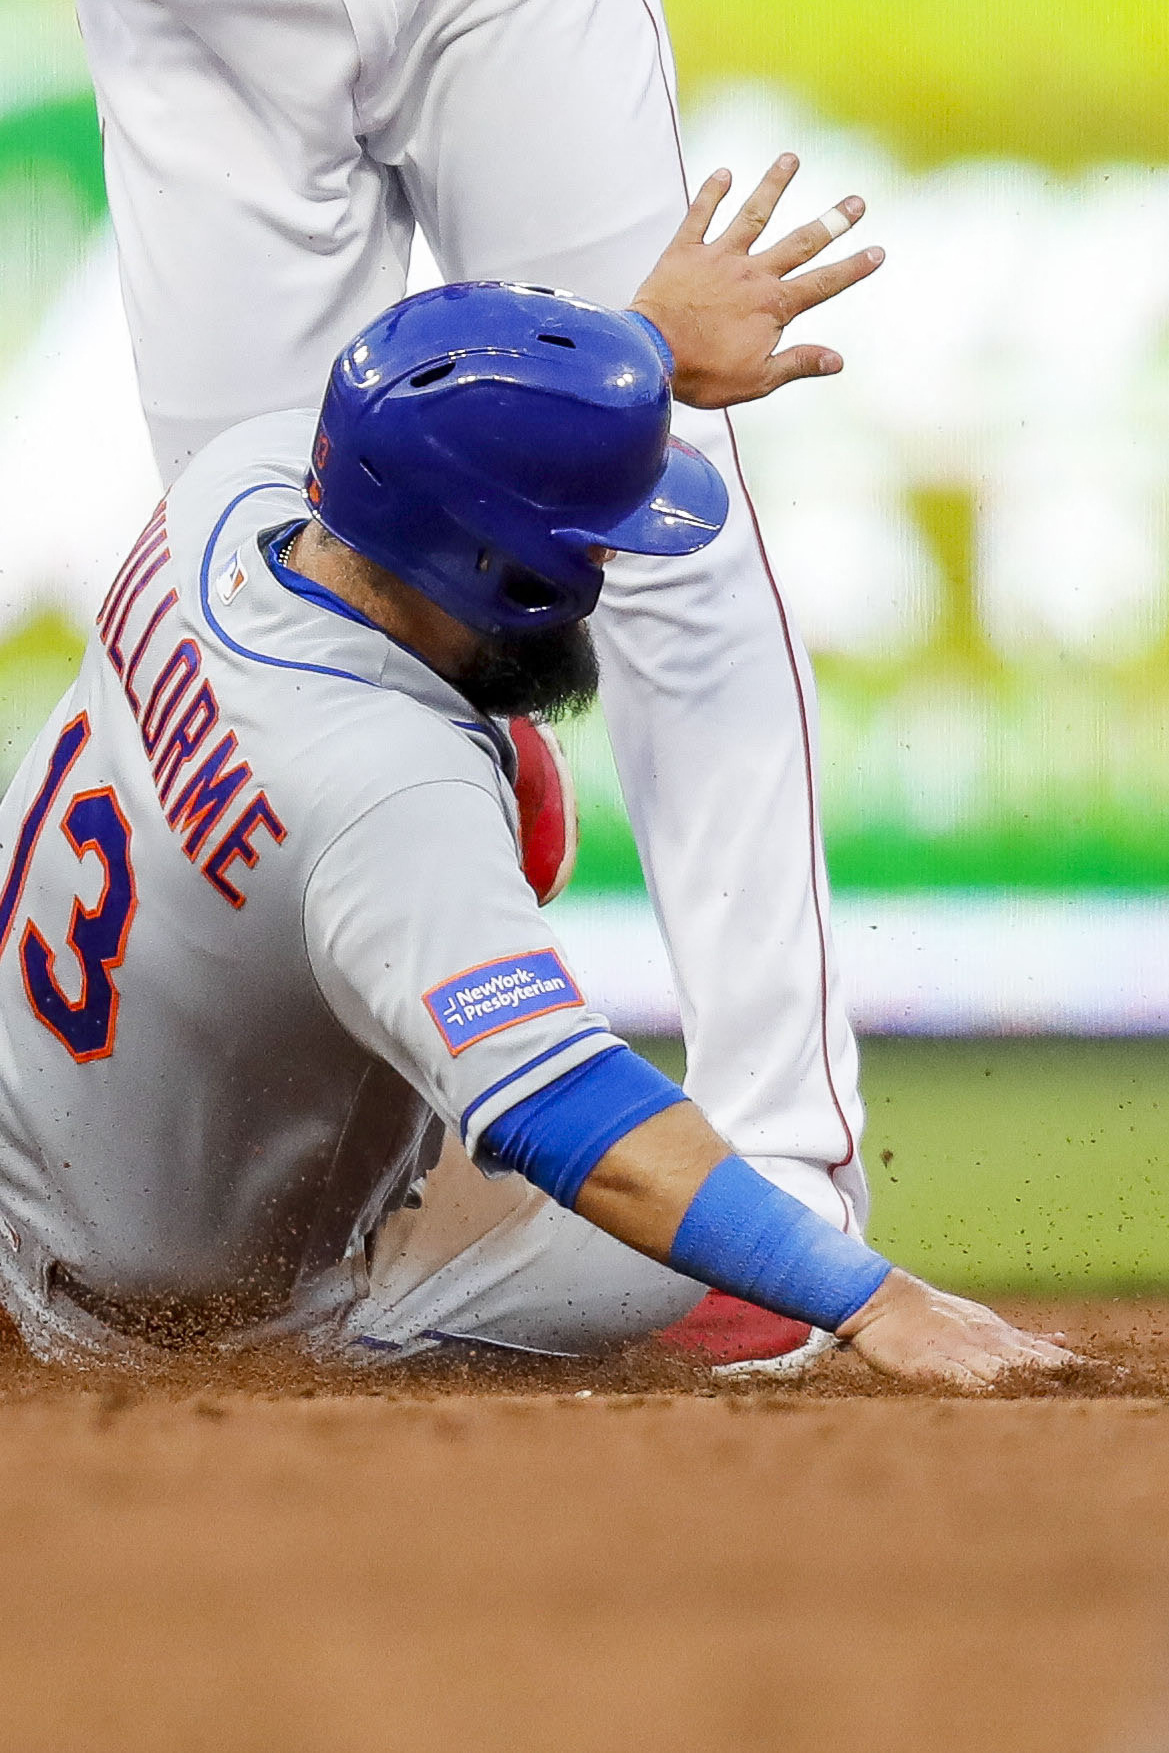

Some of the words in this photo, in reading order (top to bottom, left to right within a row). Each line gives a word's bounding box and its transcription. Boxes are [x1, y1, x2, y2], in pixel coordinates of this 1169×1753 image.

[96, 500, 288, 910] UILLORME
[455, 967, 536, 1007] NewYork-
[463, 977, 566, 1022] Presbyterian
